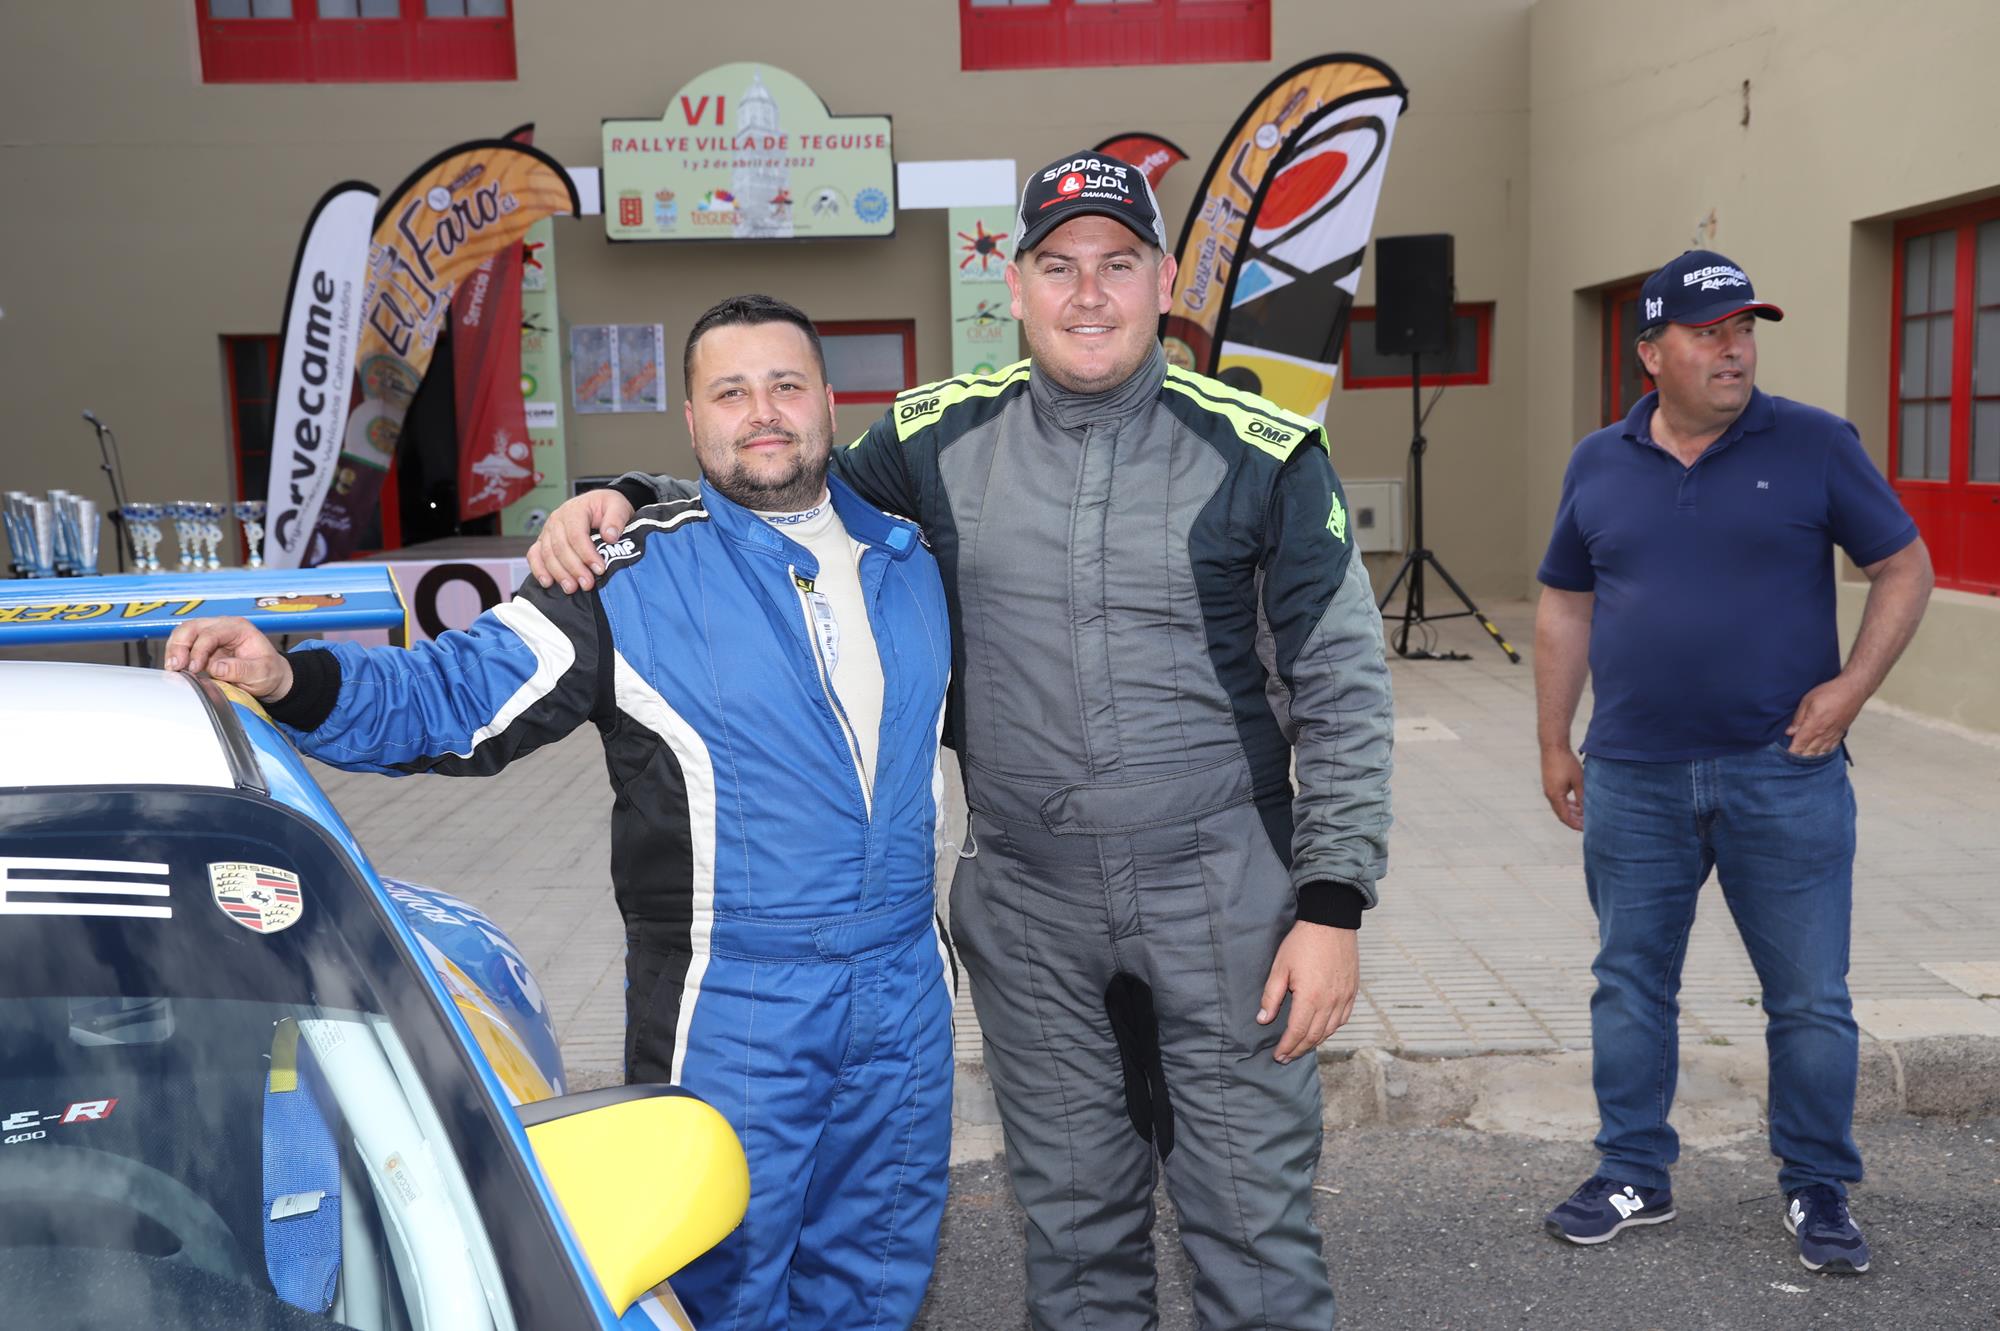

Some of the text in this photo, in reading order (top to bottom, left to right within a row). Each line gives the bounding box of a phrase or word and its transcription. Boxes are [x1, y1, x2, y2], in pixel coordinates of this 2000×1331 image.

[681, 96, 724, 126] VI
[612, 134, 886, 152] RALLYE VILLA DE TEGUISE
[683, 157, 815, 171] 1 y 2 de abril de 2022
[1042, 159, 1127, 182] SPORTS
[1085, 175, 1129, 194] YOU
[1081, 192, 1123, 201] CANARIAS
[369, 291, 415, 357] El
[398, 182, 499, 281] Faro
[339, 280, 352, 331] Medina
[1645, 297, 1663, 320] 1st
[275, 270, 335, 551] Orvecame
[901, 399, 940, 419] OMP
[1248, 422, 1291, 443] OMP
[768, 508, 820, 524] sparco
[214, 864, 295, 880] PORSCHE
[4, 1131, 46, 1144] 400
